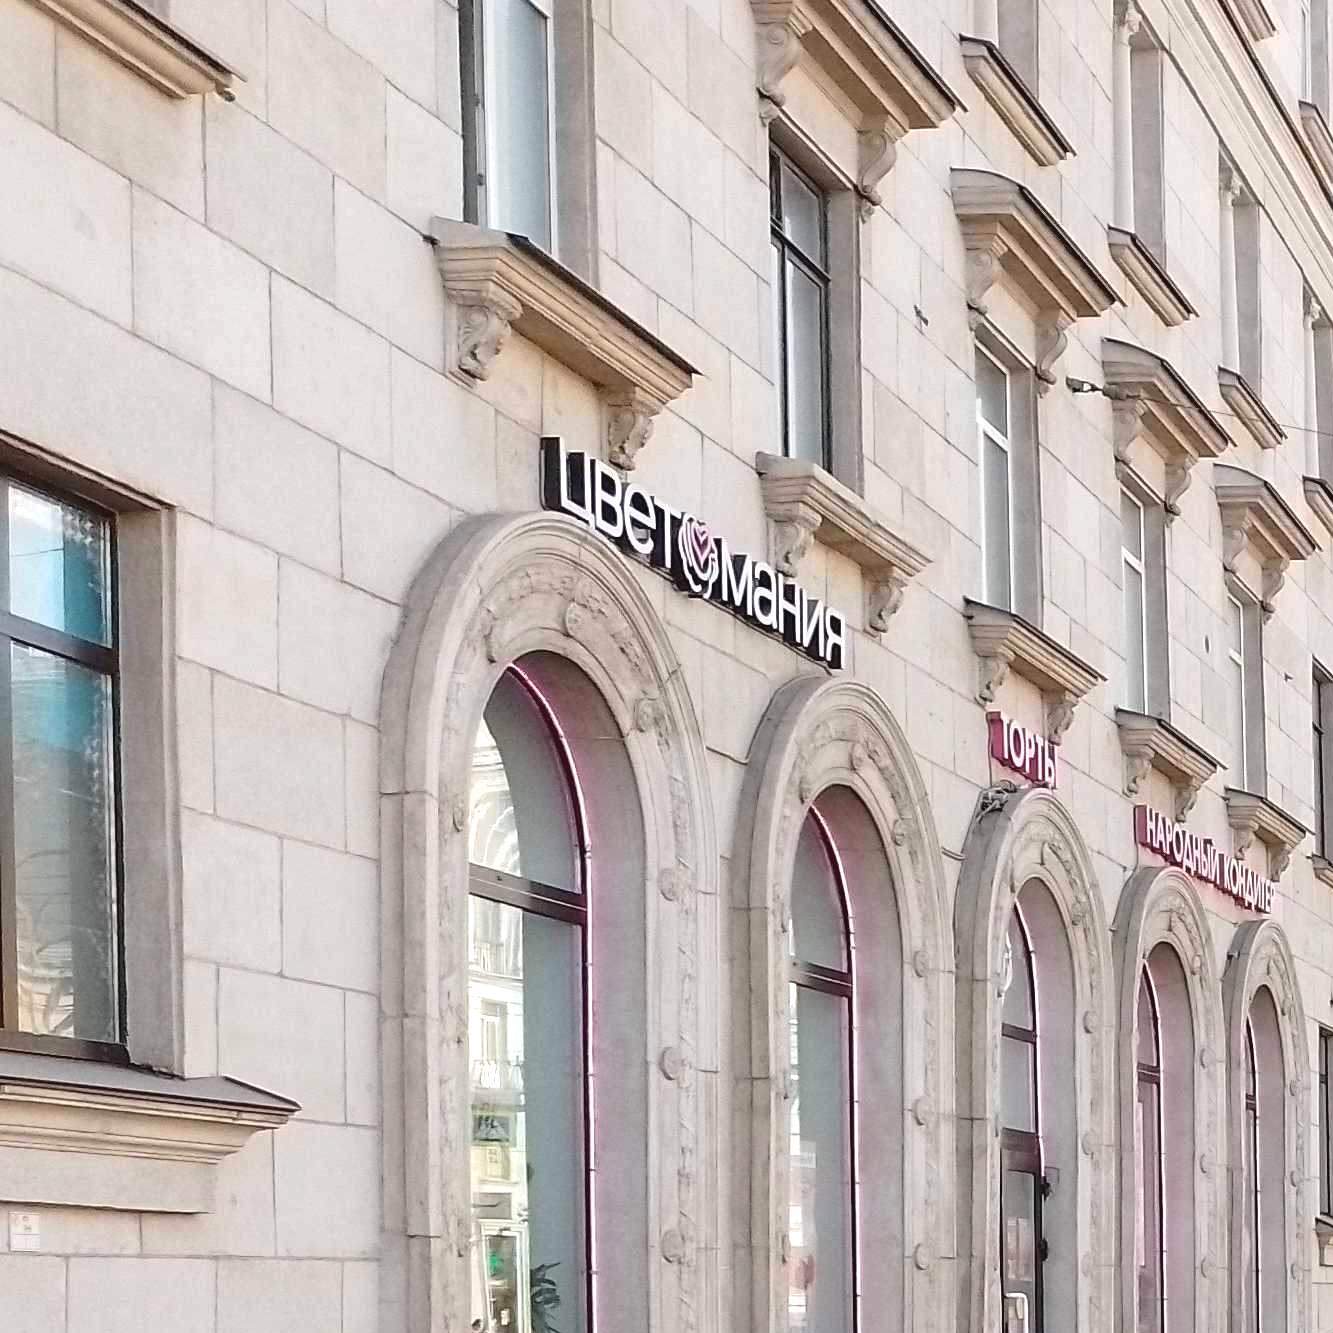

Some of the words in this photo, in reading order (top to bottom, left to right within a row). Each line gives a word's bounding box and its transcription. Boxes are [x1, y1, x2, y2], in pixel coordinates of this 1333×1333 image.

[999, 708, 1058, 790] ТОРТЫ
[1146, 804, 1220, 886] НАРОДНЫЙ
[1223, 855, 1276, 914] КОНДИТЕР
